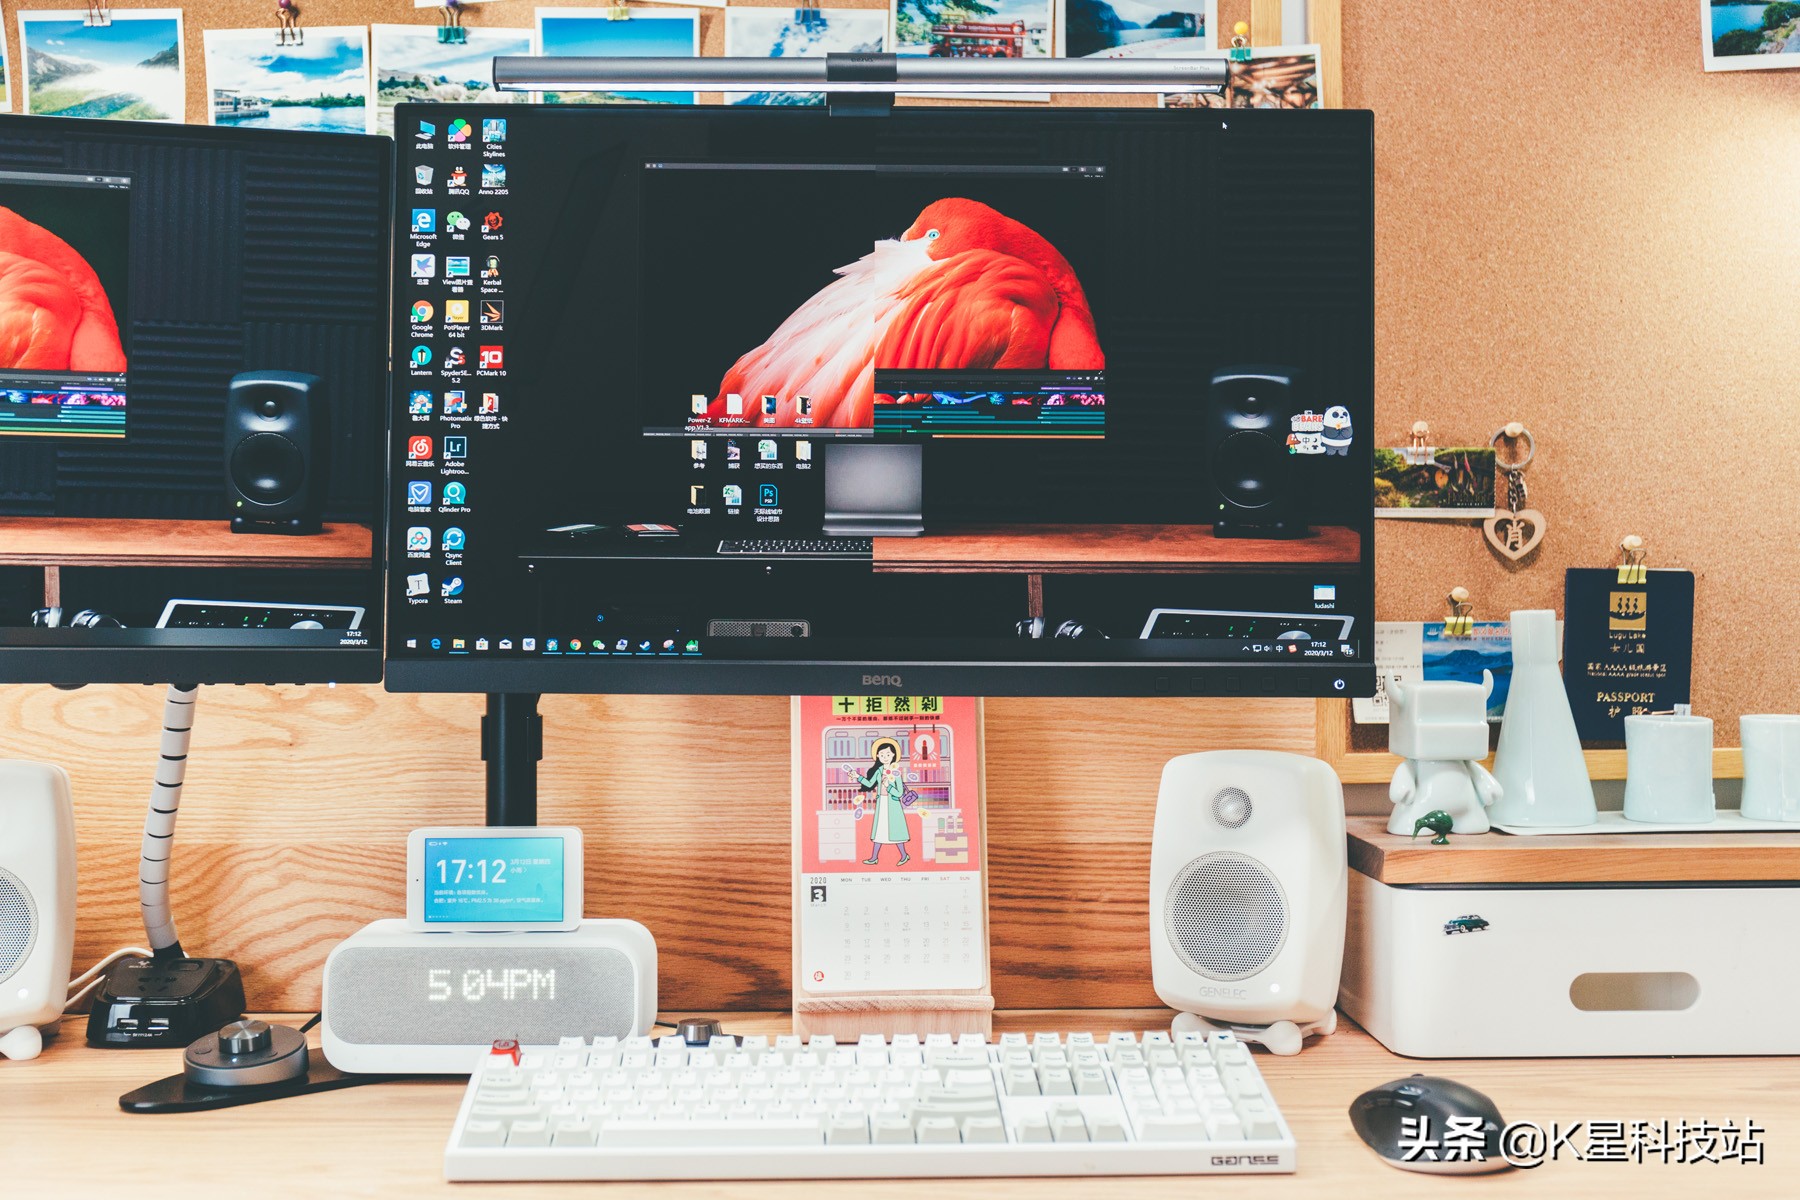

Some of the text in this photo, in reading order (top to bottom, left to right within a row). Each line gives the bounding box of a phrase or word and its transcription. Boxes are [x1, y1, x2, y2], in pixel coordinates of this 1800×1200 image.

[411, 324, 433, 332] Google
[1609, 632, 1627, 640] Lugu
[1597, 691, 1655, 703] PASSPORT
[436, 859, 507, 884] 17:12
[1200, 986, 1247, 1000] GENELEC
